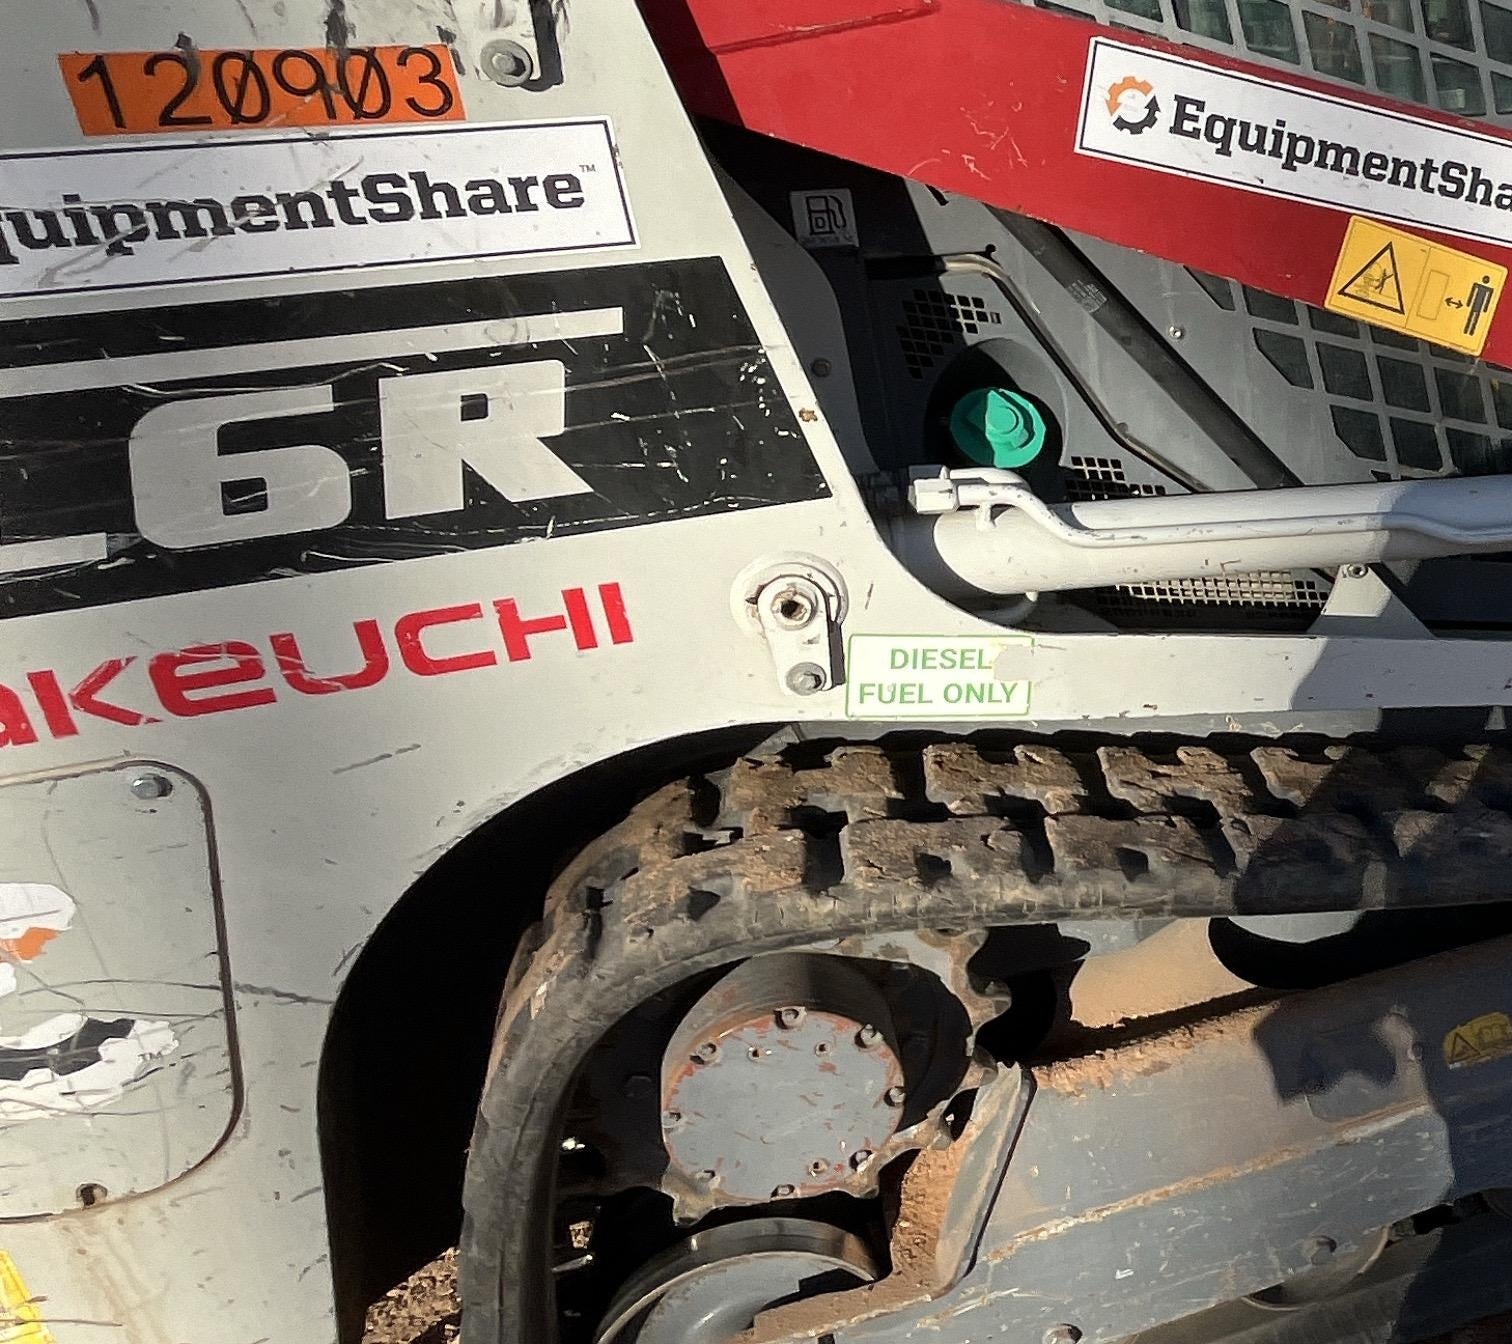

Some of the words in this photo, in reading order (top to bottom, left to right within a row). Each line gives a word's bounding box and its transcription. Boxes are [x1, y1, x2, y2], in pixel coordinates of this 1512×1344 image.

[889, 647, 993, 670] DIESEL
[858, 682, 934, 705] FUEL
[942, 682, 1019, 705] ONLY
